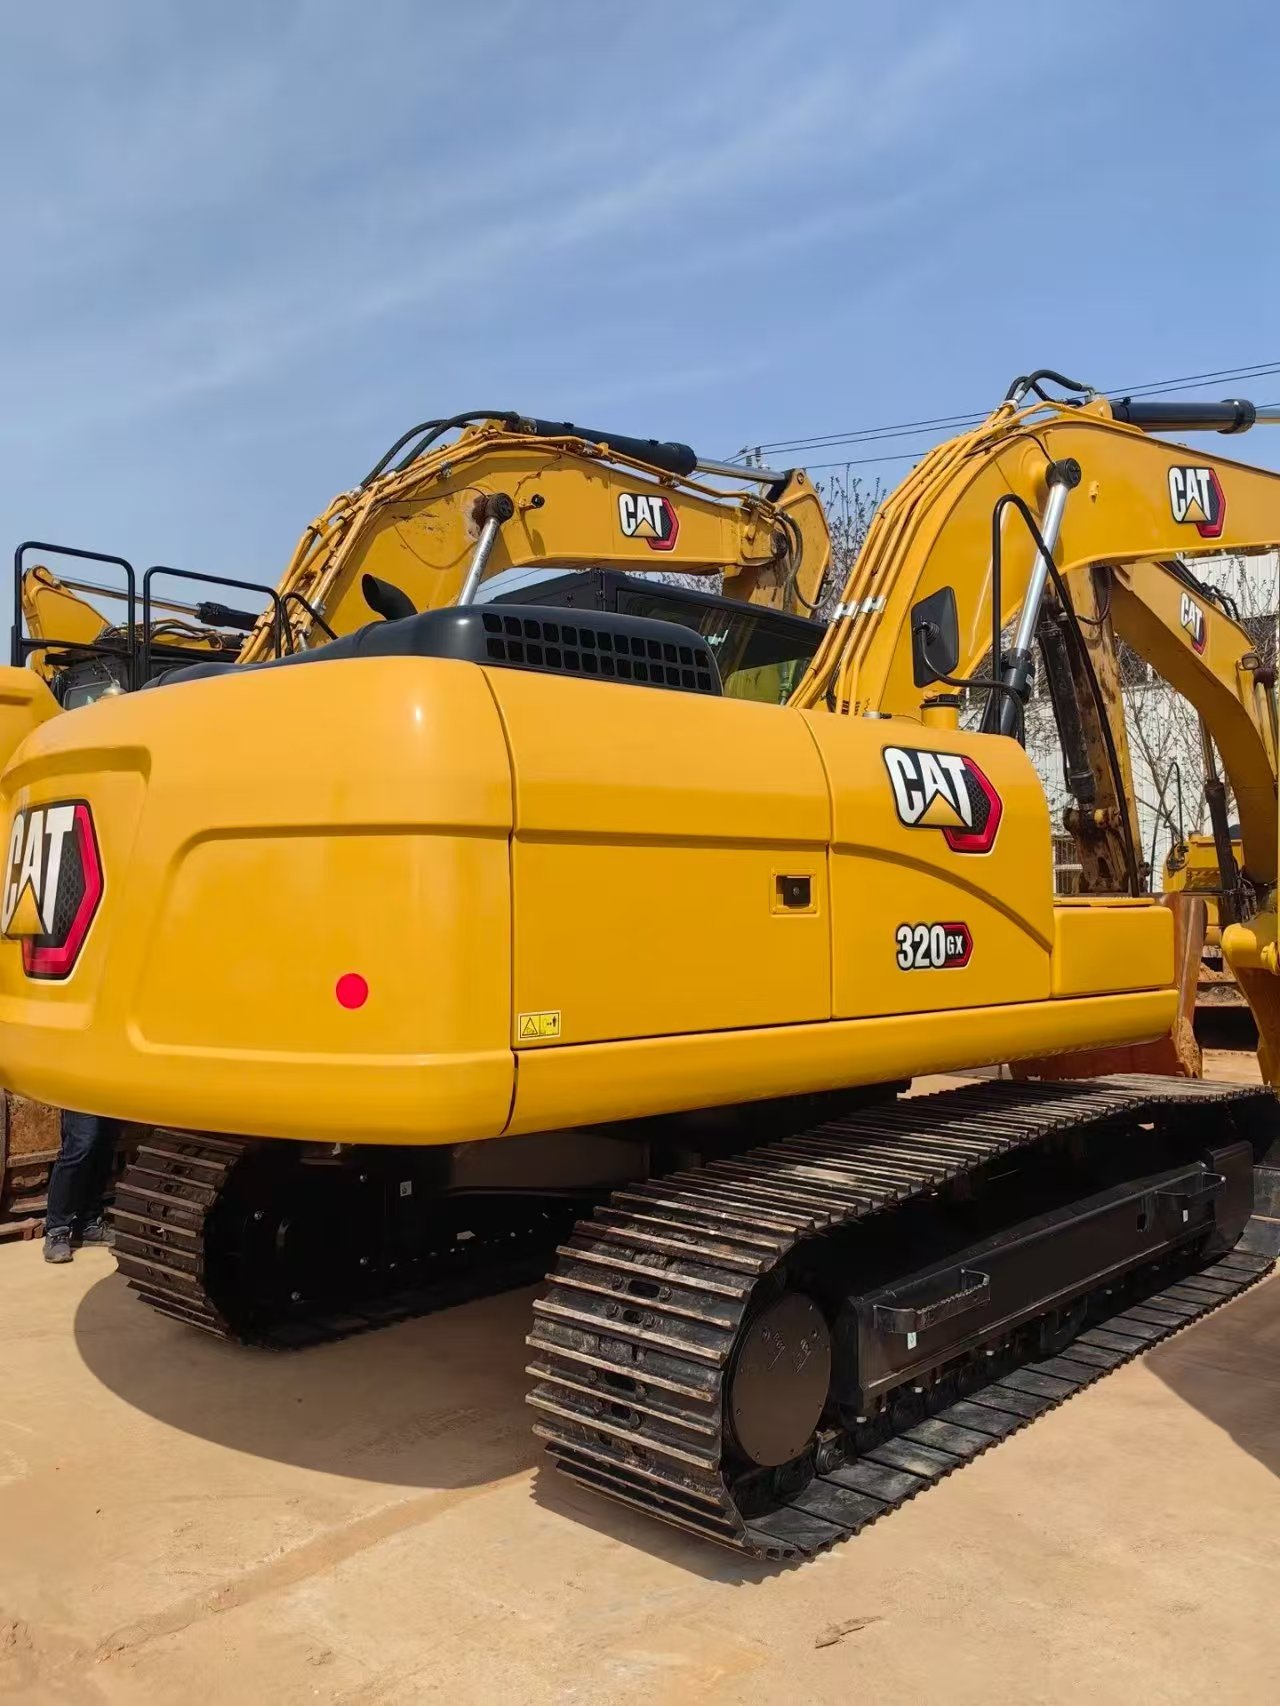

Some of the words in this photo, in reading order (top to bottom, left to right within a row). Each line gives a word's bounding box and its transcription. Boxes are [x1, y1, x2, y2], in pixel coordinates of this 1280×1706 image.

[619, 493, 663, 537] CAT
[1169, 467, 1211, 521] CAT
[1181, 592, 1202, 641] CAT
[884, 747, 972, 827] CAT
[0, 805, 75, 934] CAT
